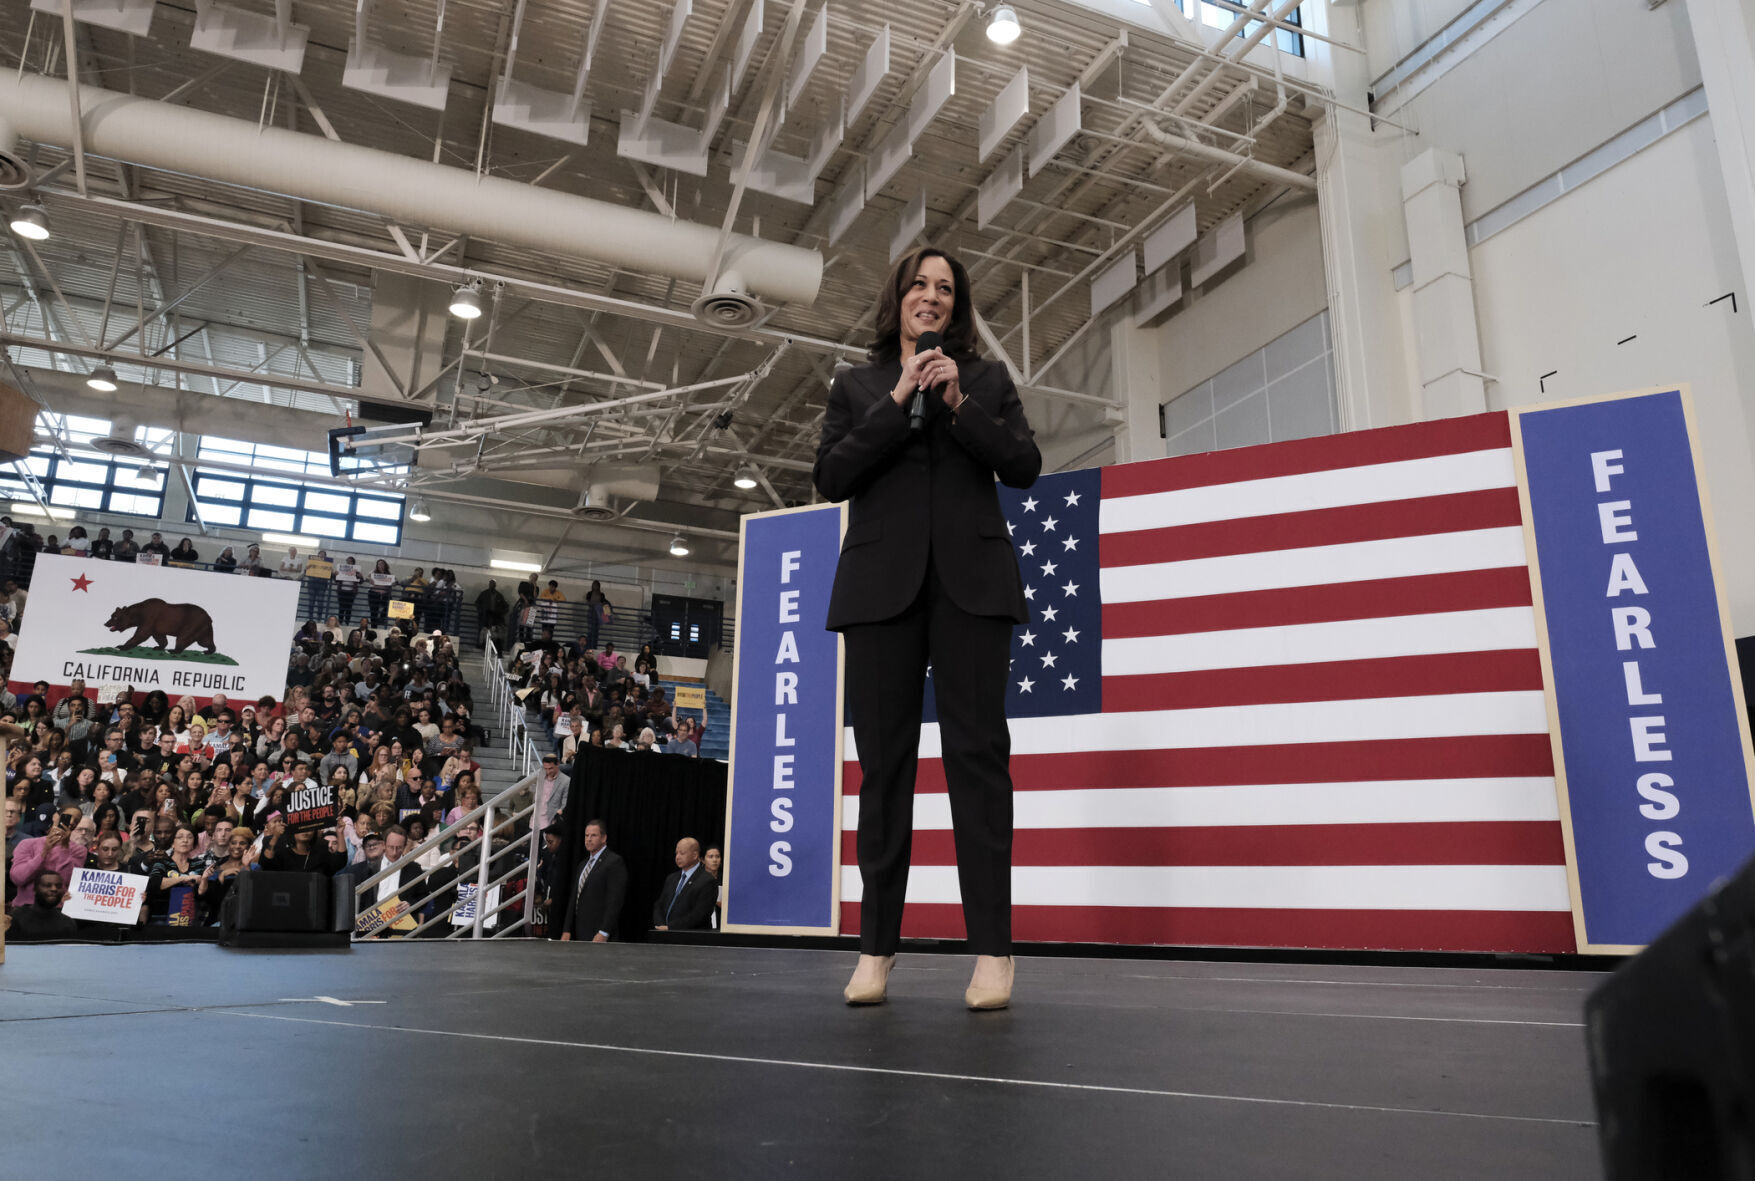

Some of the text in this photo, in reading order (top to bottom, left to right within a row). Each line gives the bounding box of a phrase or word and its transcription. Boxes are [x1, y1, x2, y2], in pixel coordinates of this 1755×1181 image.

[63, 661, 245, 691] CALIFORNIA REPUBLIC
[1590, 449, 1689, 880] FEARLESS
[768, 550, 801, 877] FEARLESS
[286, 785, 334, 813] JUSTICE
[287, 805, 334, 825] FOR THE PEOPLE
[78, 881, 136, 898] HARRIS FOR
[81, 870, 123, 885] KAMALA
[83, 893, 134, 909] THE PEOPLE
